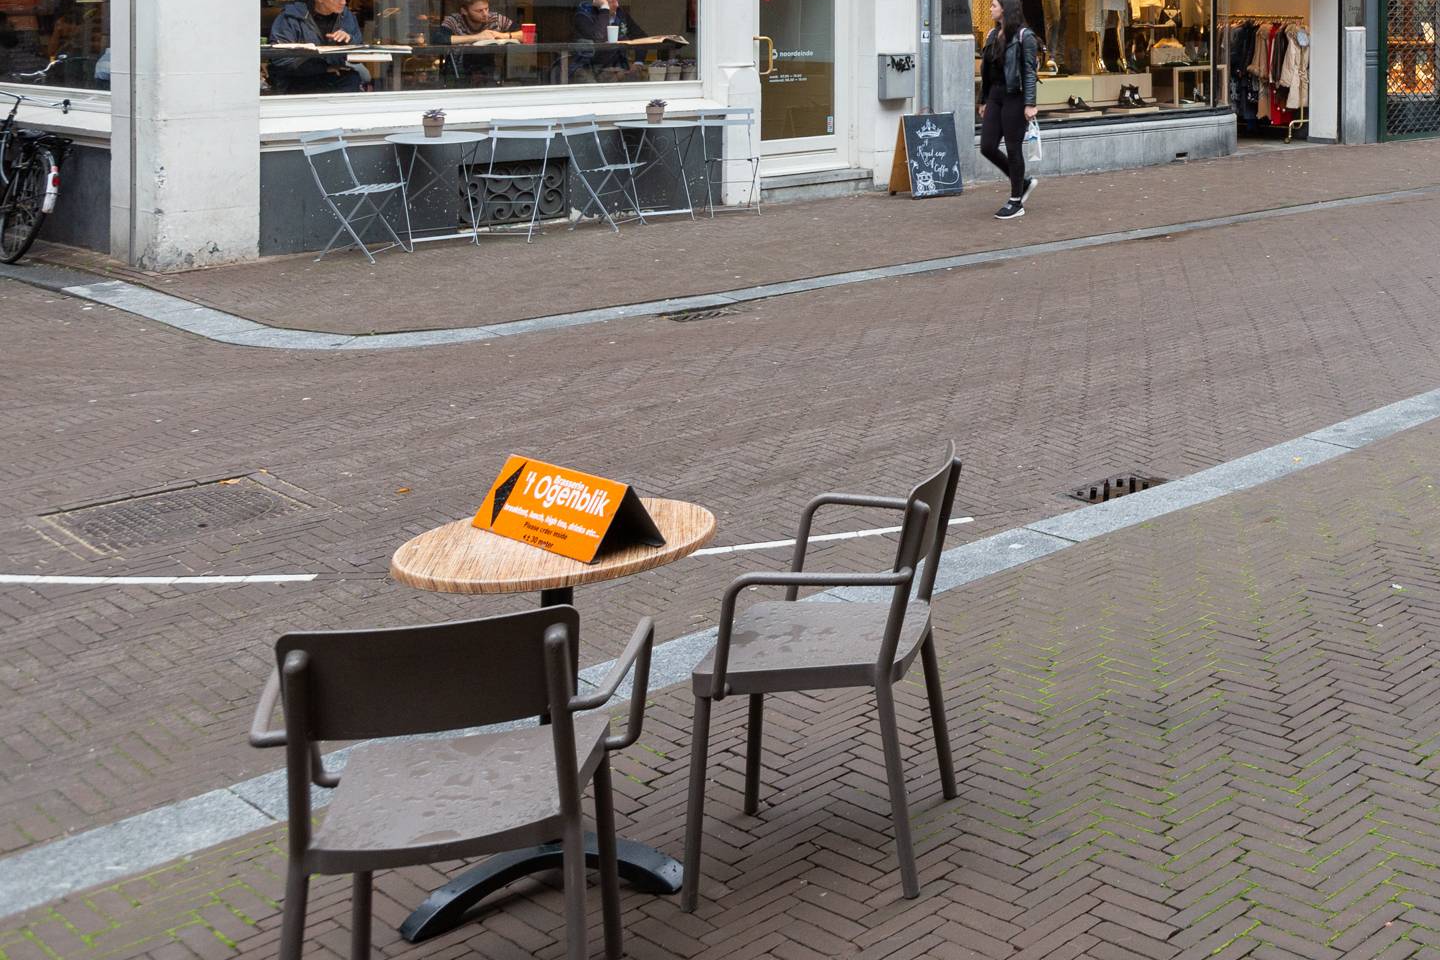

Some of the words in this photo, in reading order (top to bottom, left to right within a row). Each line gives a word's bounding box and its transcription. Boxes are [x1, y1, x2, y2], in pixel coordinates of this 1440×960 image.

[779, 49, 814, 58] noordeinde
[534, 475, 610, 517] Ogenblik
[523, 520, 540, 533] Please
